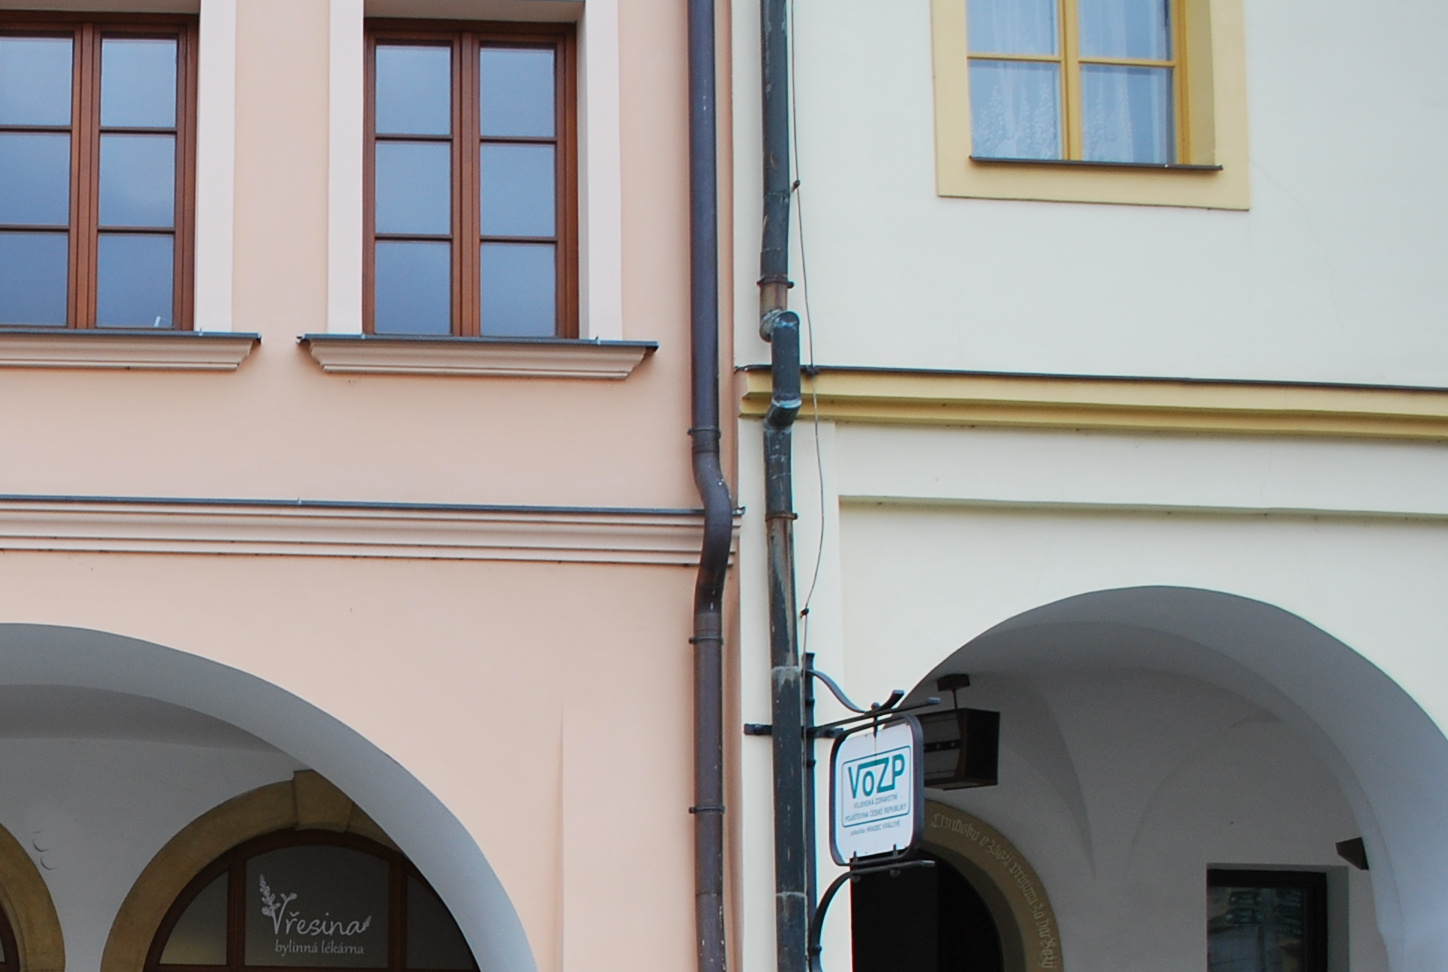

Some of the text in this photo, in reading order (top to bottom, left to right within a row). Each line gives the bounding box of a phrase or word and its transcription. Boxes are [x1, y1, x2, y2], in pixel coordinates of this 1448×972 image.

[259, 876, 371, 936] Vřesina
[275, 939, 364, 957] bylinná lékárna
